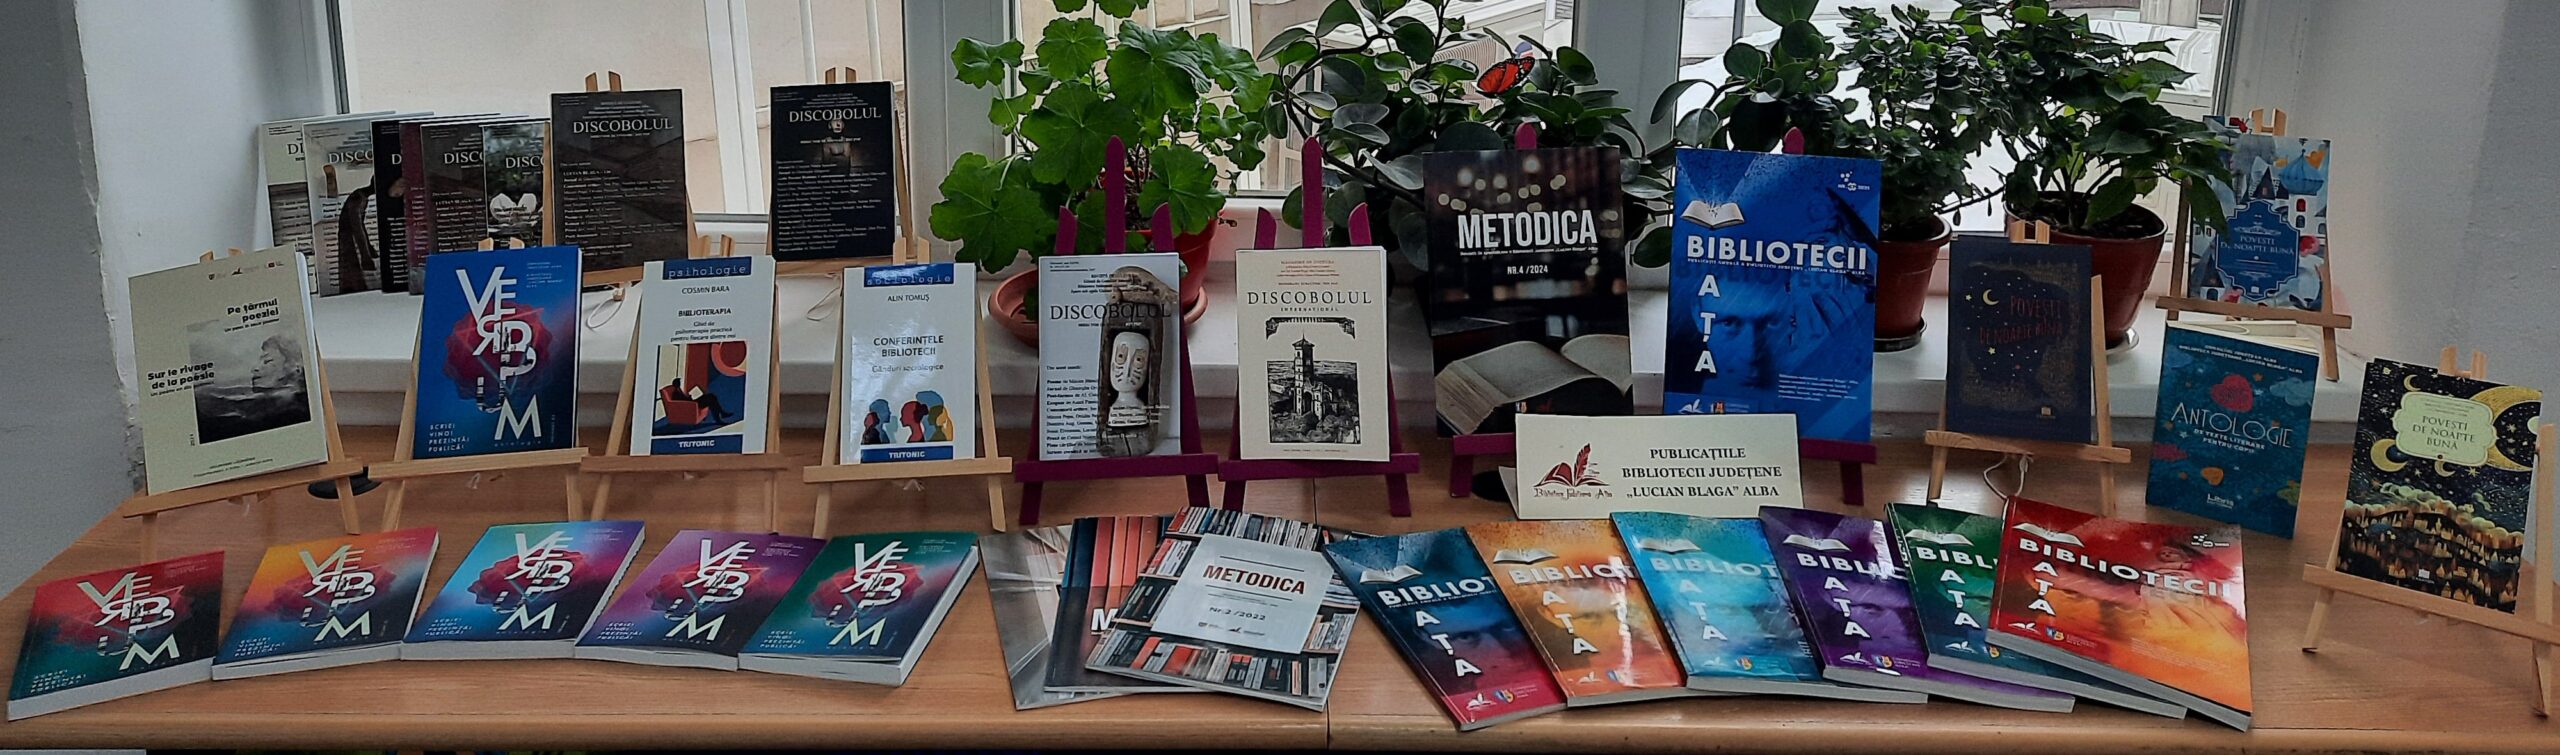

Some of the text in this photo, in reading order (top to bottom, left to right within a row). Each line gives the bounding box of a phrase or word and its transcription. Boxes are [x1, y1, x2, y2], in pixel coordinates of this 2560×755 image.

[789, 107, 882, 123] DISCOBOLUL
[573, 118, 674, 133] DISCOBOLUL
[1457, 210, 1598, 249] METODICA
[1687, 235, 1867, 270] BIBLIOTECII
[668, 266, 746, 279] psihologie
[1247, 291, 1371, 305] DISCOBOLUL
[227, 307, 241, 315] Pe
[678, 308, 731, 317] BIBLIOTERAPIA
[1050, 302, 1171, 320] DISCOBOLUL
[881, 347, 936, 358] BIBLIOTECII
[148, 372, 165, 380] Sur
[180, 362, 213, 374] rivage
[152, 382, 165, 390] de
[2171, 402, 2293, 448] ANTOLOGIE
[678, 439, 715, 448] TRITONIC
[889, 451, 925, 459] TRITONIC
[1650, 448, 1746, 461] PUBLICAȚIILE
[1622, 466, 1783, 480] BIBLIOTECII JUDEȚENE
[1742, 486, 1780, 497] ALBA
[1916, 546, 1997, 570] BIBL
[2019, 538, 2231, 598] BIBLIOTECII
[1203, 565, 1305, 595] METODICA
